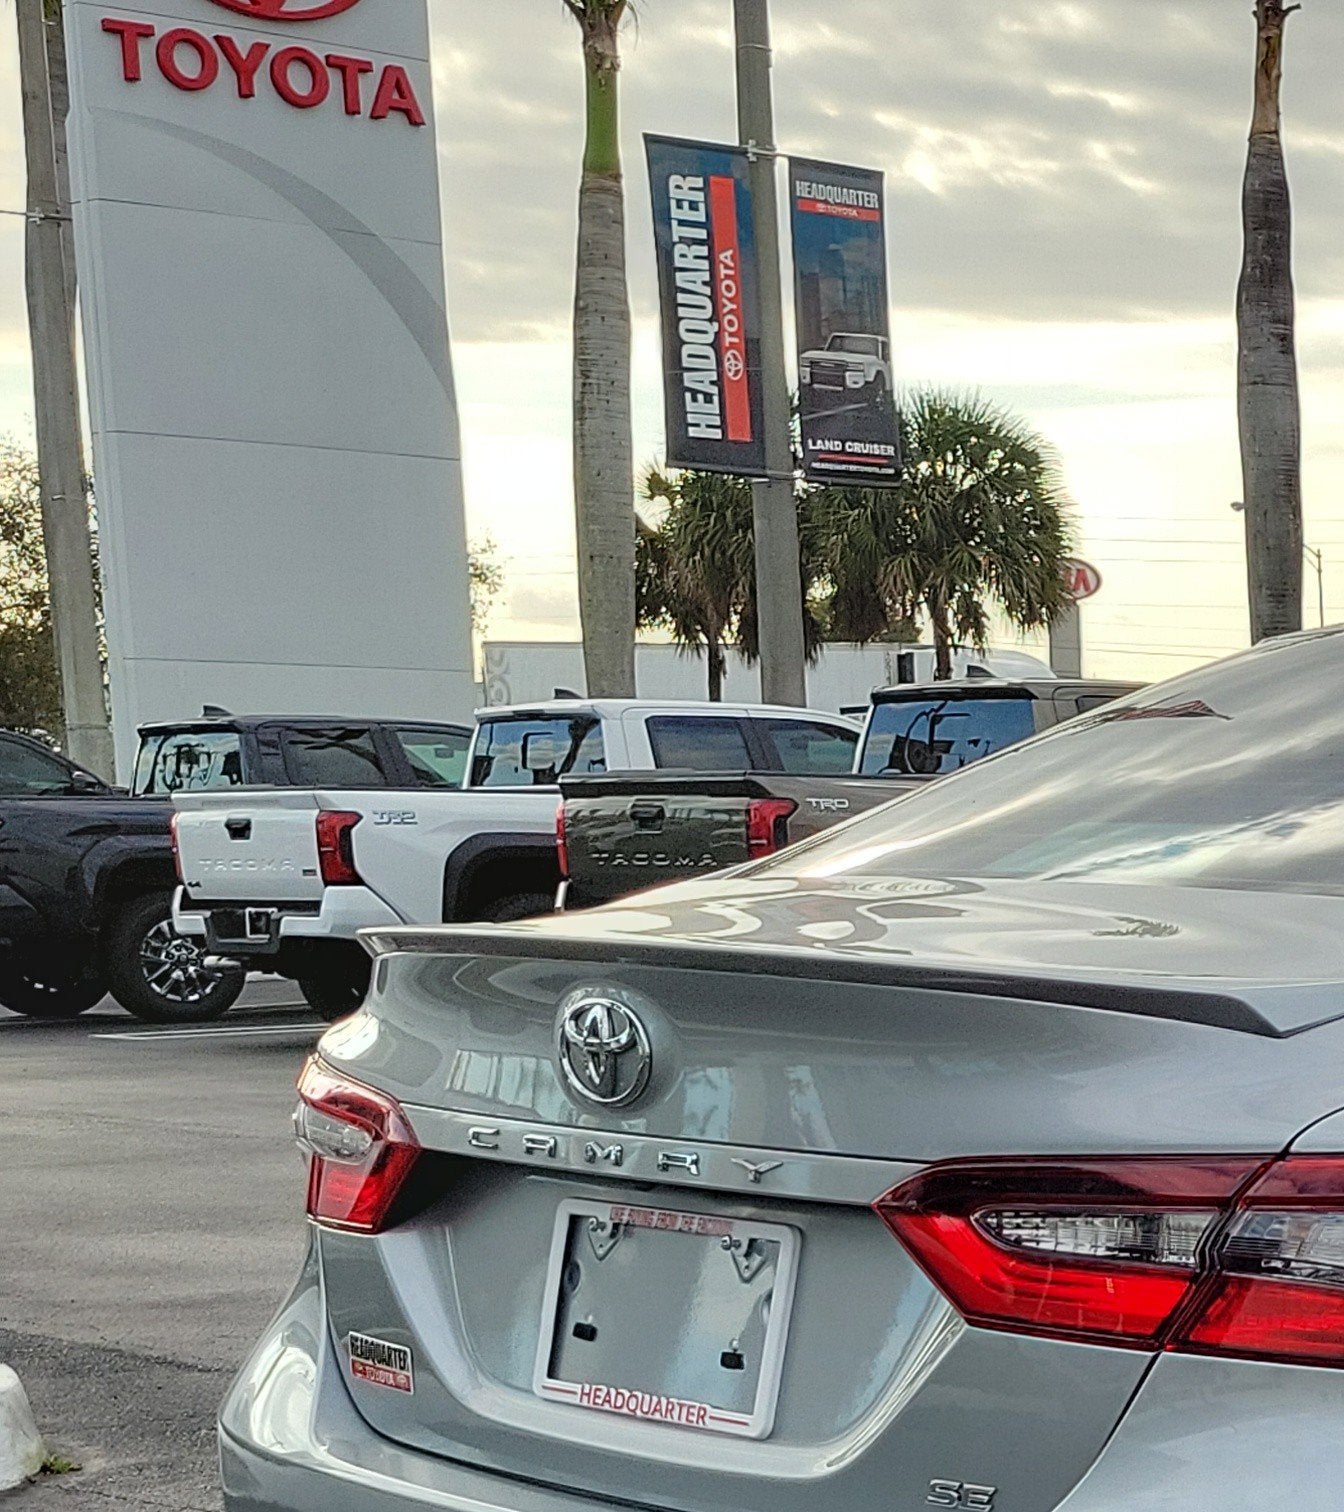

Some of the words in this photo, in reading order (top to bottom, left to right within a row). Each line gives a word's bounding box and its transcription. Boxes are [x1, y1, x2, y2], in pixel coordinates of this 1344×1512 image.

[101, 17, 427, 126] TOYOTA
[795, 180, 879, 209] HEADQUARTER
[828, 205, 859, 217] TOYOTA
[668, 174, 722, 440] HEADQUARTER
[719, 249, 740, 347] TOYOTA
[808, 438, 842, 452] LAND
[845, 441, 895, 456] CRUISER
[805, 797, 849, 811] TRD
[198, 858, 295, 871] TACOMA
[591, 853, 718, 867] TACOMA
[468, 1126, 784, 1184] CAMRY
[579, 1384, 708, 1426] HEADQUARTER
[925, 1478, 998, 1512] SE
